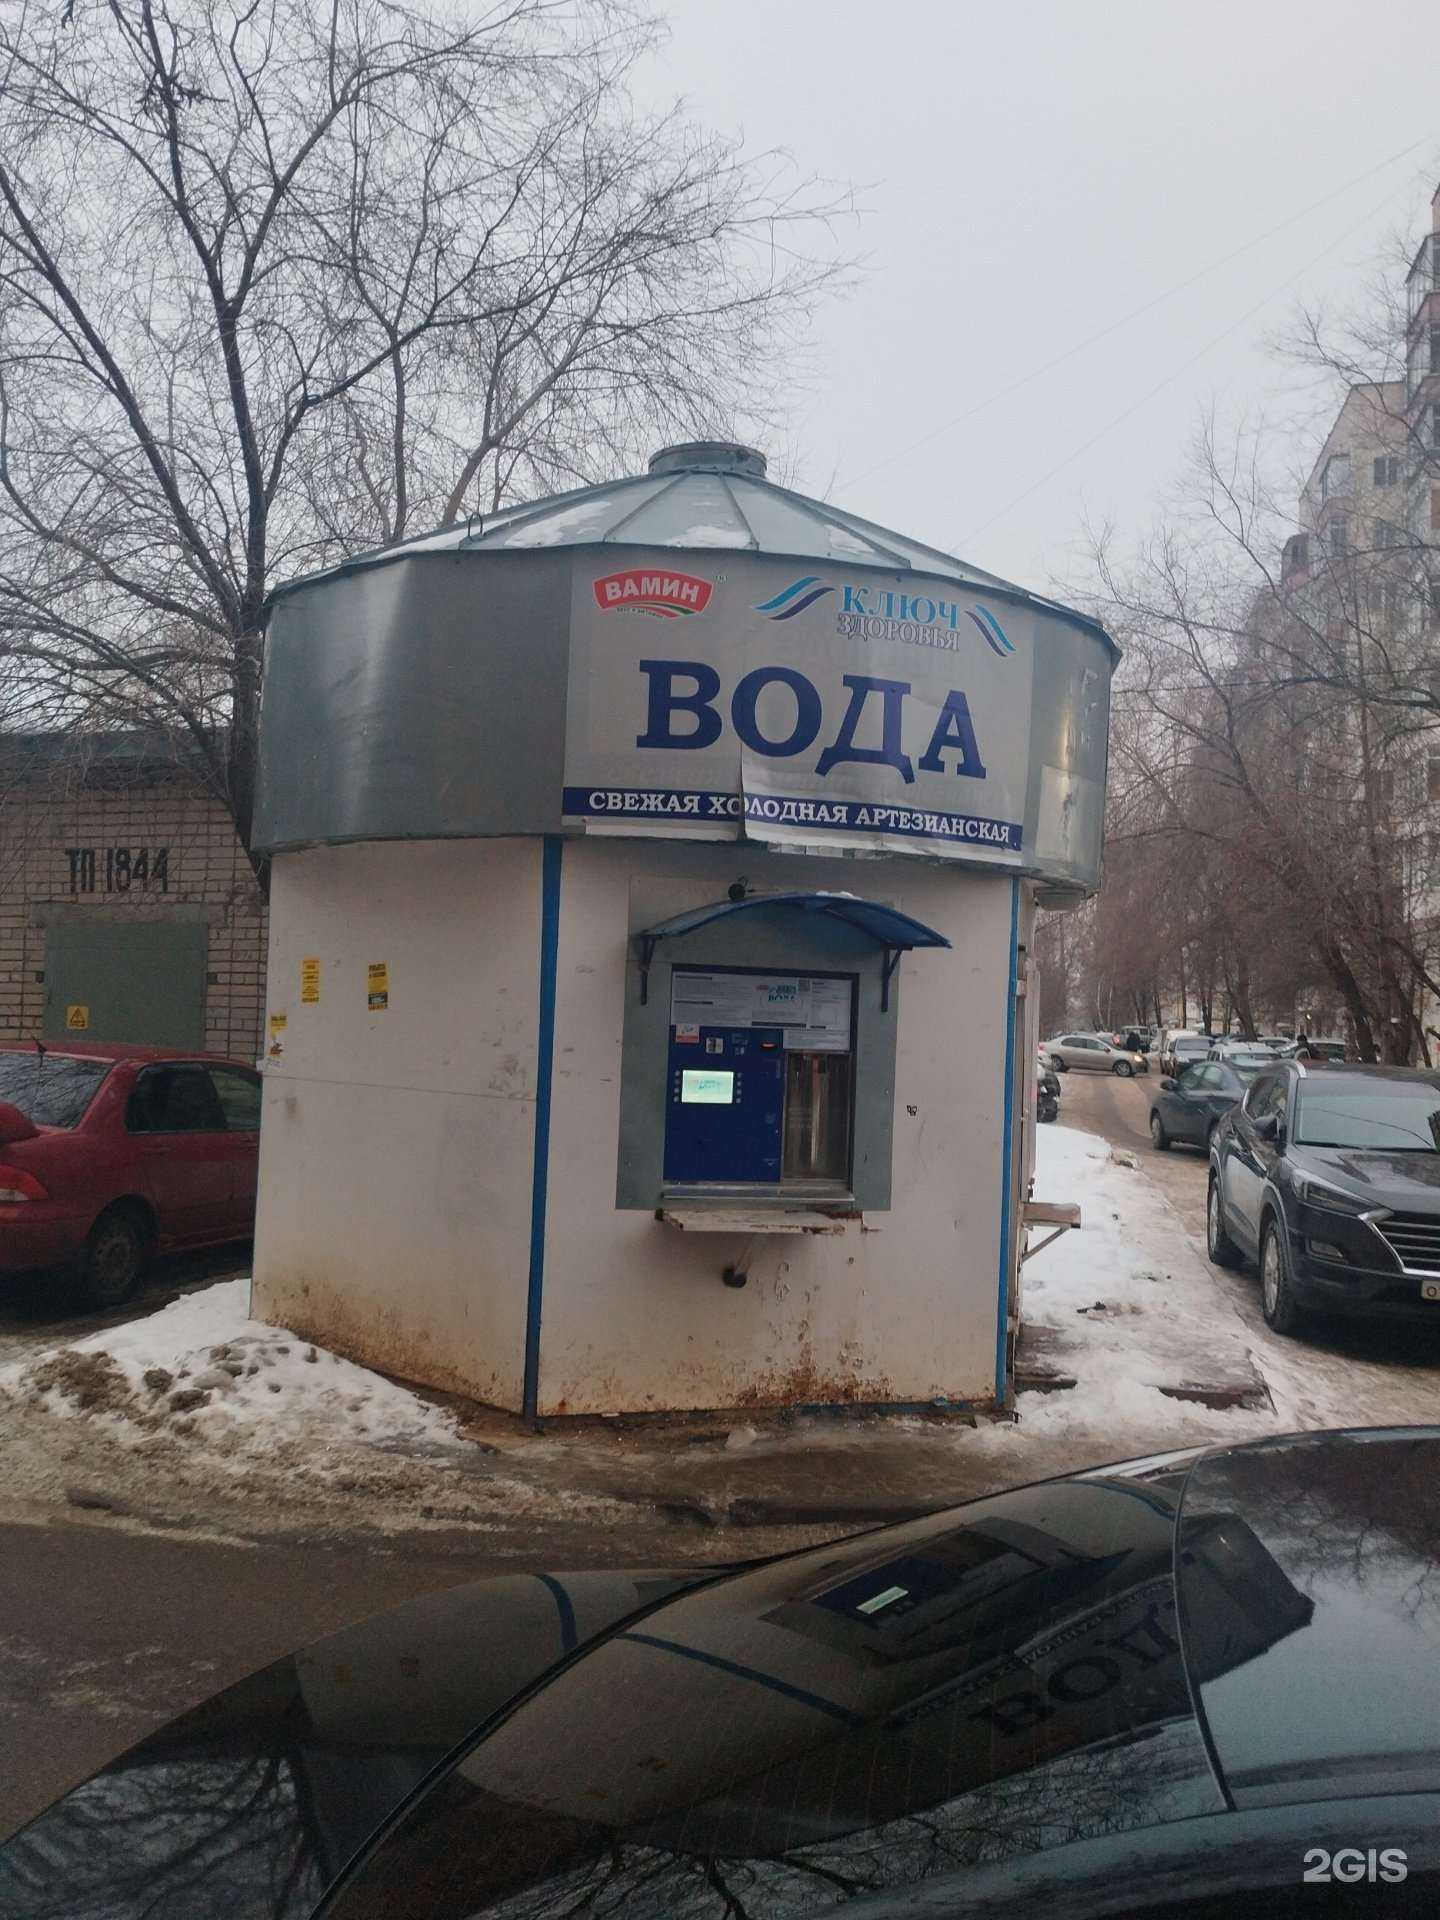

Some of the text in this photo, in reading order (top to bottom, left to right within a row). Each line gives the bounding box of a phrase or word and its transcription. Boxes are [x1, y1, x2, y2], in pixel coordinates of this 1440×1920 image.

[604, 575, 700, 603] ВАМИН
[842, 585, 959, 631] КЛЮЧ
[837, 613, 960, 652] ЗДОРОВЬЯ
[636, 660, 986, 783] ВОДА
[589, 792, 1009, 843] СВЕЖАЯ ХОЛОДНАЯ АРТЕЗИАНСКАЯ
[65, 847, 168, 895] ТП 1844
